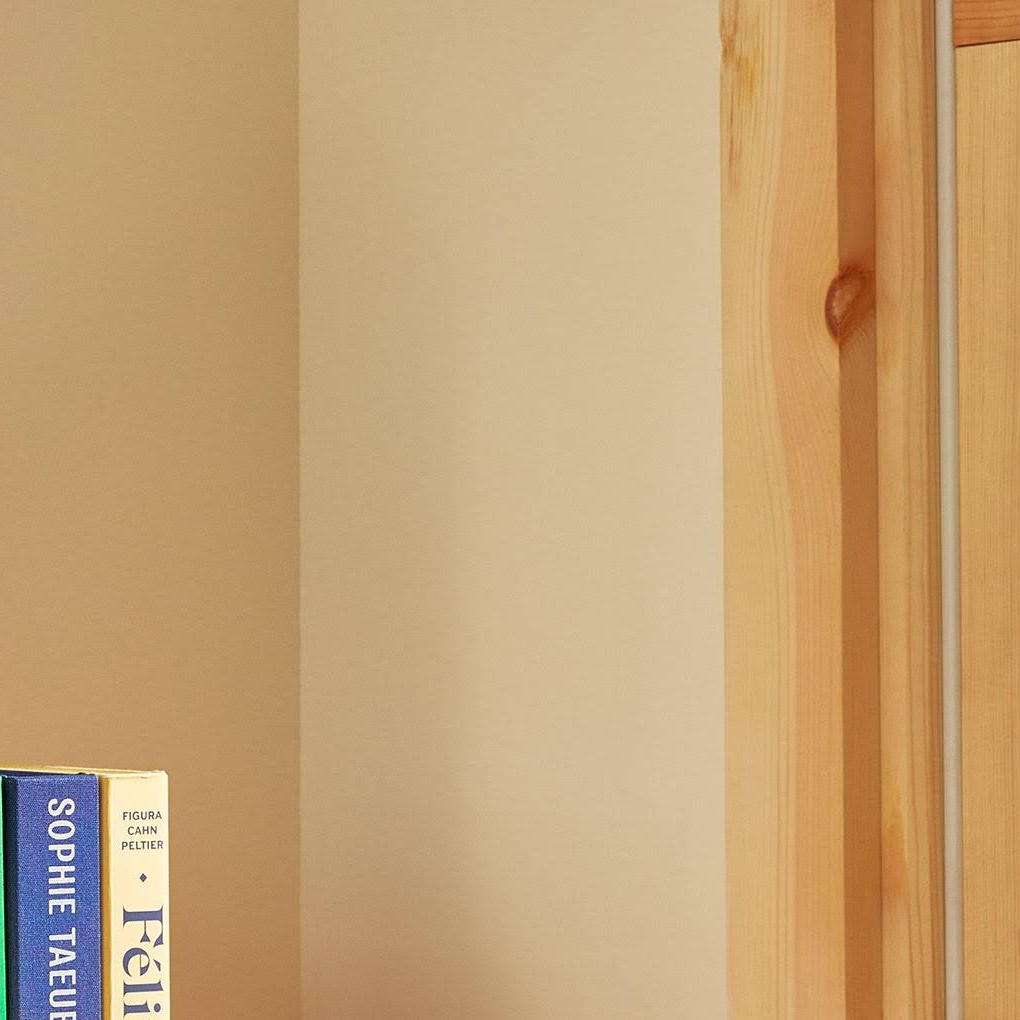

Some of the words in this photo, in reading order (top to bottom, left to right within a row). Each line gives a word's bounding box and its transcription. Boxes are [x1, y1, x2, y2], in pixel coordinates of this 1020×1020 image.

[122, 811, 163, 821] FIGURA
[127, 825, 158, 836] CAHN
[121, 840, 164, 851] PELTIER
[47, 798, 76, 915] SOPHIE
